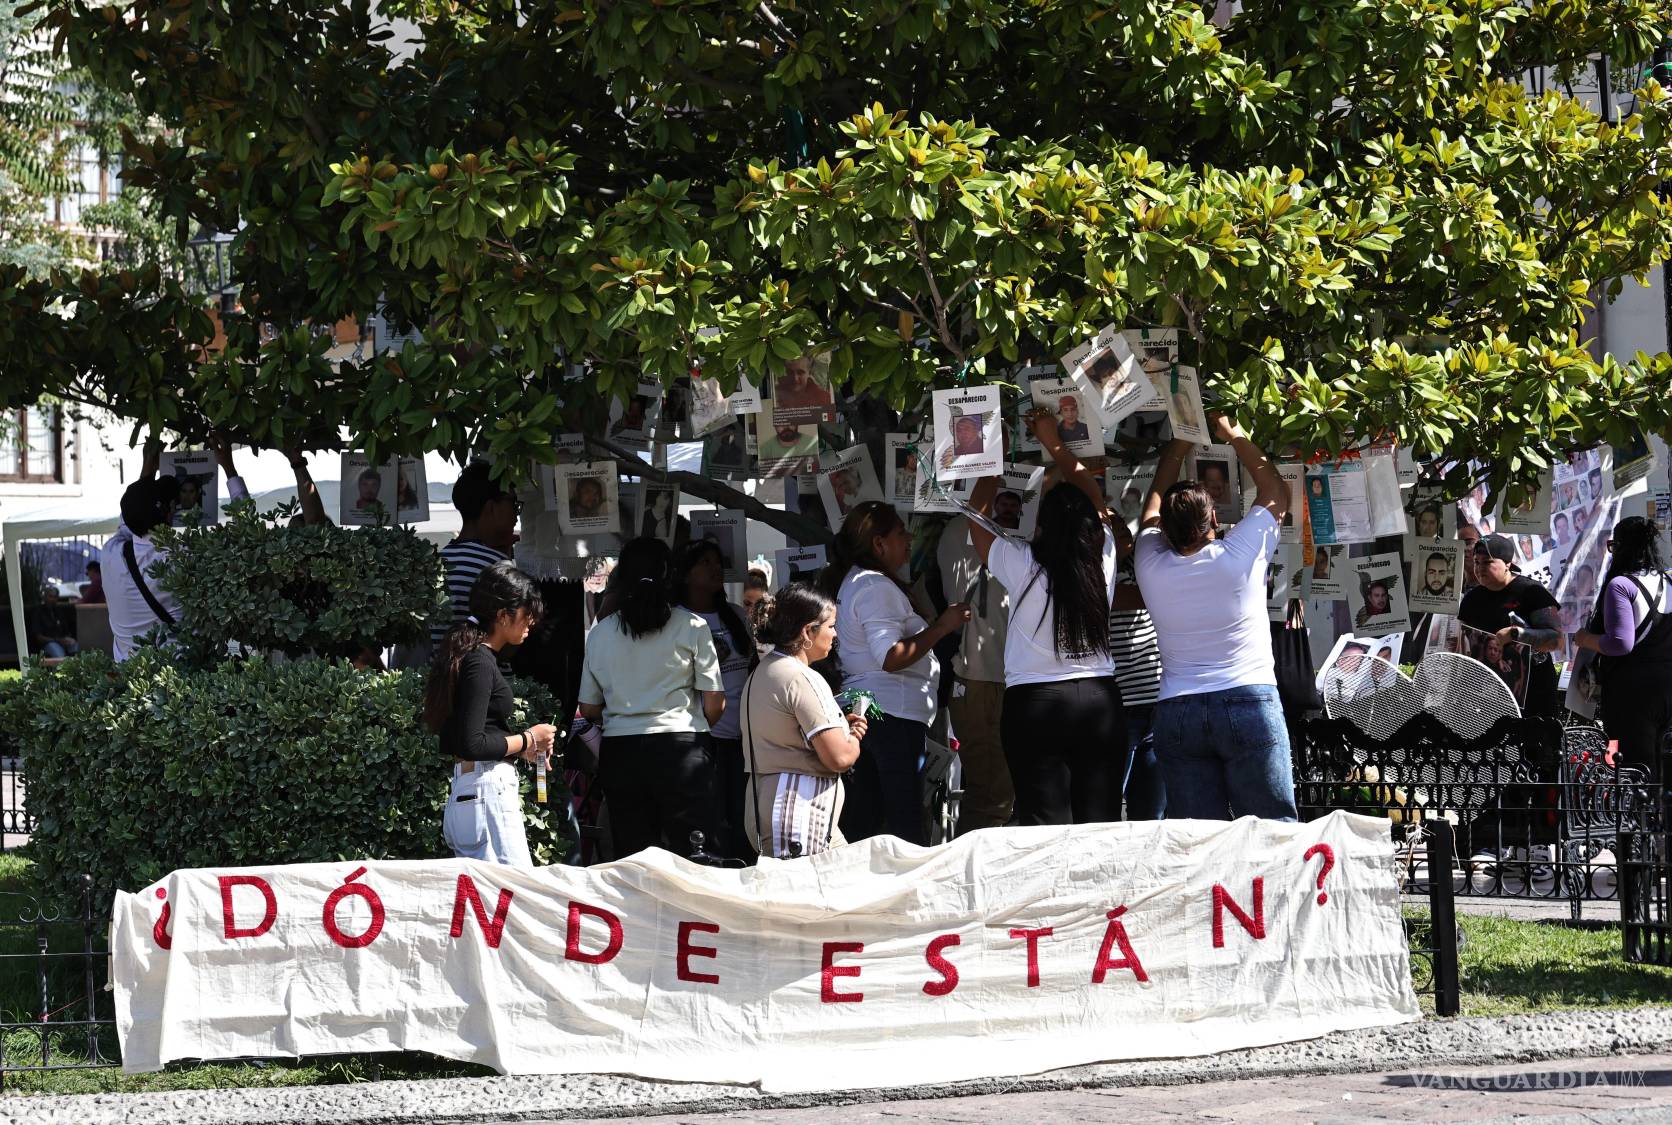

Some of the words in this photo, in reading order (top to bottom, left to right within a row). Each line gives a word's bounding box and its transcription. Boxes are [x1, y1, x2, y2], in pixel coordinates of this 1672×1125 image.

[1072, 336, 1114, 367] Desaparecido
[948, 395, 987, 405] DESAPARECIDO
[564, 470, 609, 479] Desaparecido
[1418, 544, 1458, 553] Desaparecido
[820, 843, 1336, 1004] ESTÁN?
